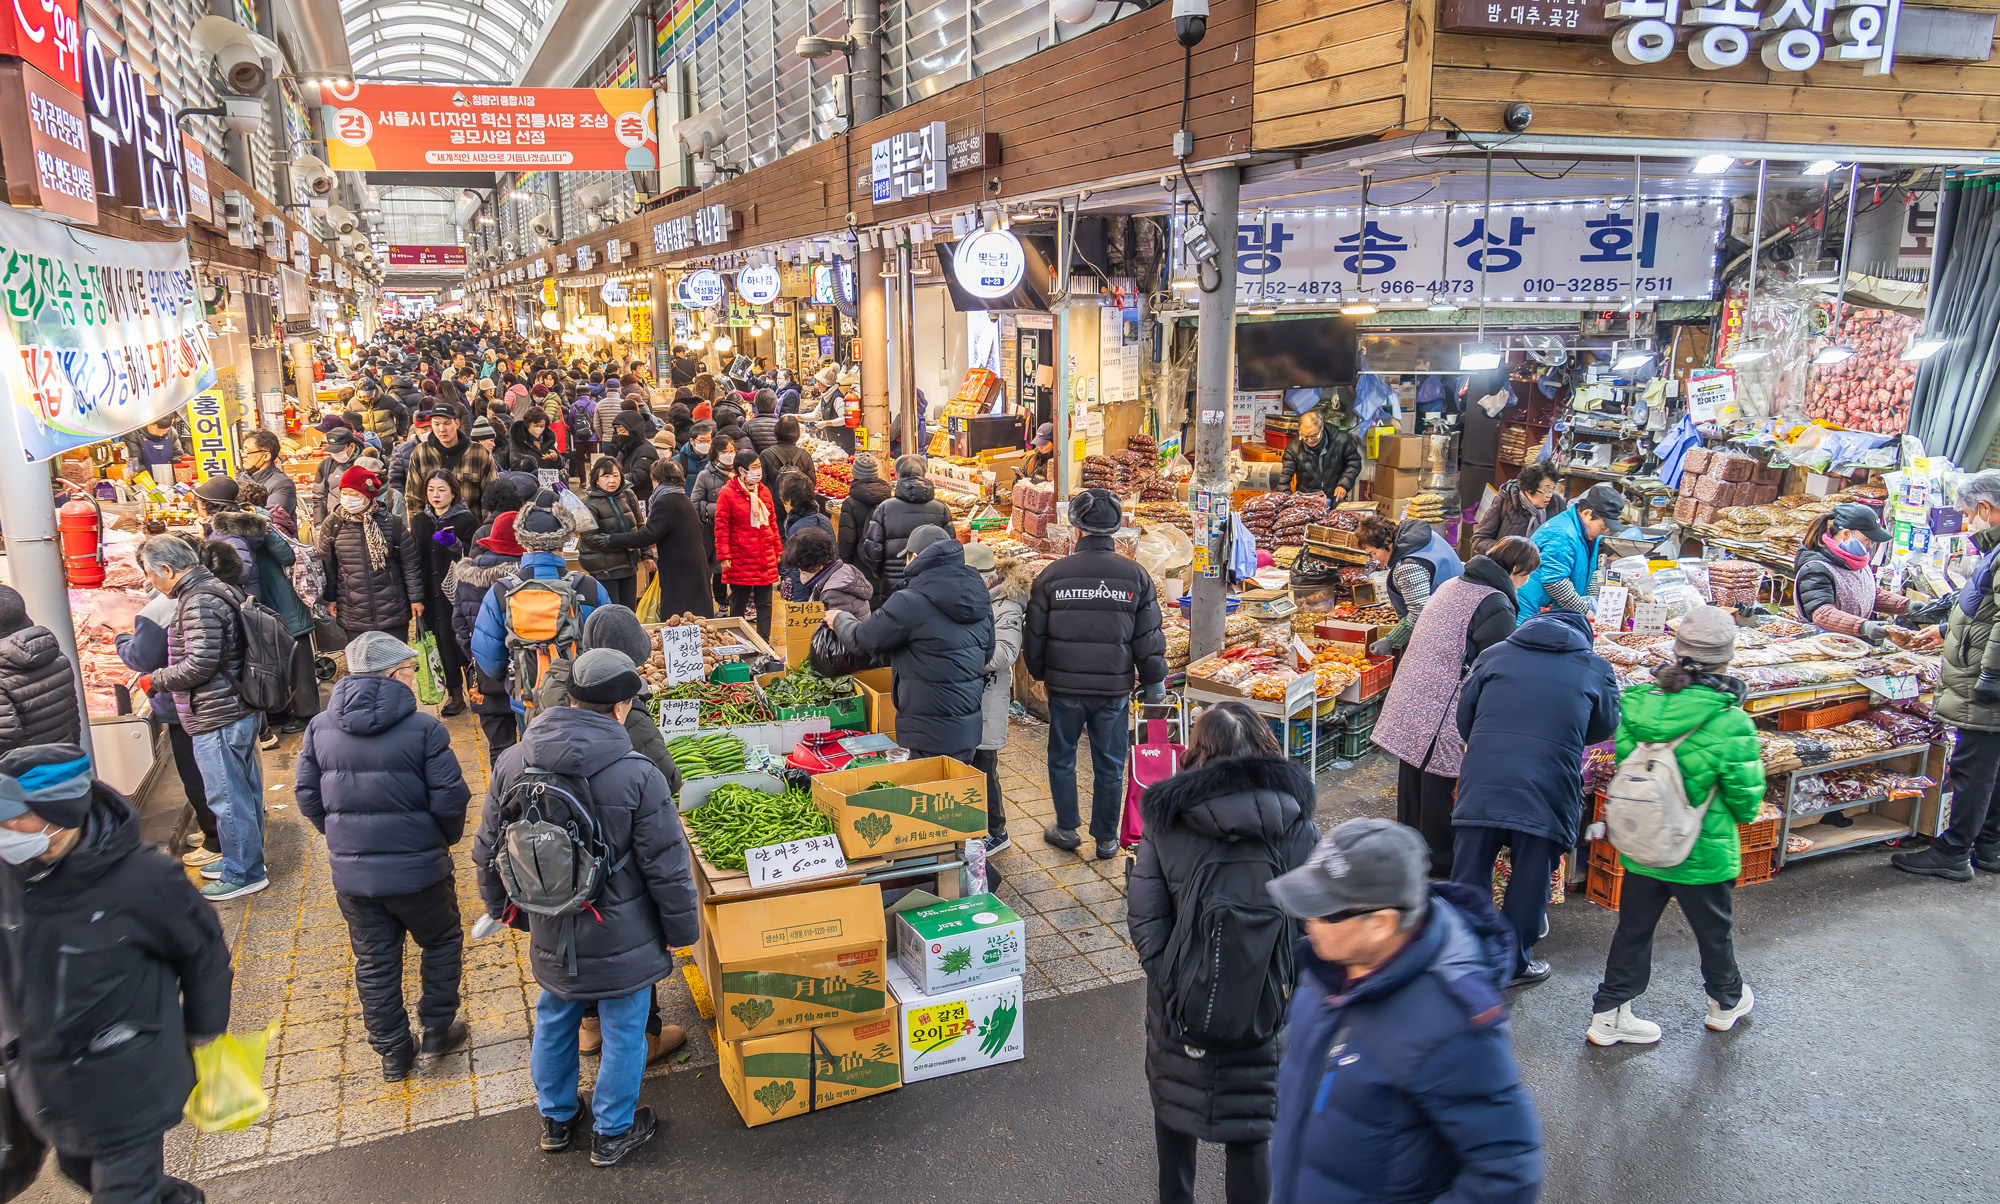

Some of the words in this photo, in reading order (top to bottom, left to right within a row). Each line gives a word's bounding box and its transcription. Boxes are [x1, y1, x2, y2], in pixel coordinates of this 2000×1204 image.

[85, 28, 187, 227] 우아농장
[339, 114, 366, 139] 경
[378, 111, 426, 127] 서울시
[429, 112, 477, 128] 디자인
[480, 113, 512, 128] 혁신
[515, 113, 576, 129] 전통시장
[579, 113, 609, 129] 조성
[450, 129, 512, 145] 공모사업
[516, 130, 546, 145] 선정
[621, 117, 644, 141] 축
[473, 153, 505, 163] 시장으로
[695, 204, 721, 246] 하나김
[747, 275, 773, 286] 하나김
[1380, 278, 1474, 295] 966-4873
[1522, 276, 1673, 294] 010-3285-7511
[127, 268, 150, 320] 바로
[193, 395, 229, 478] 홍어무침
[1055, 588, 1126, 600] MATTERHORN
[682, 626, 700, 643] 매운
[765, 932, 786, 944] 생산자
[937, 1007, 965, 1023] 갈전
[1003, 1044, 1019, 1053] 10kg
